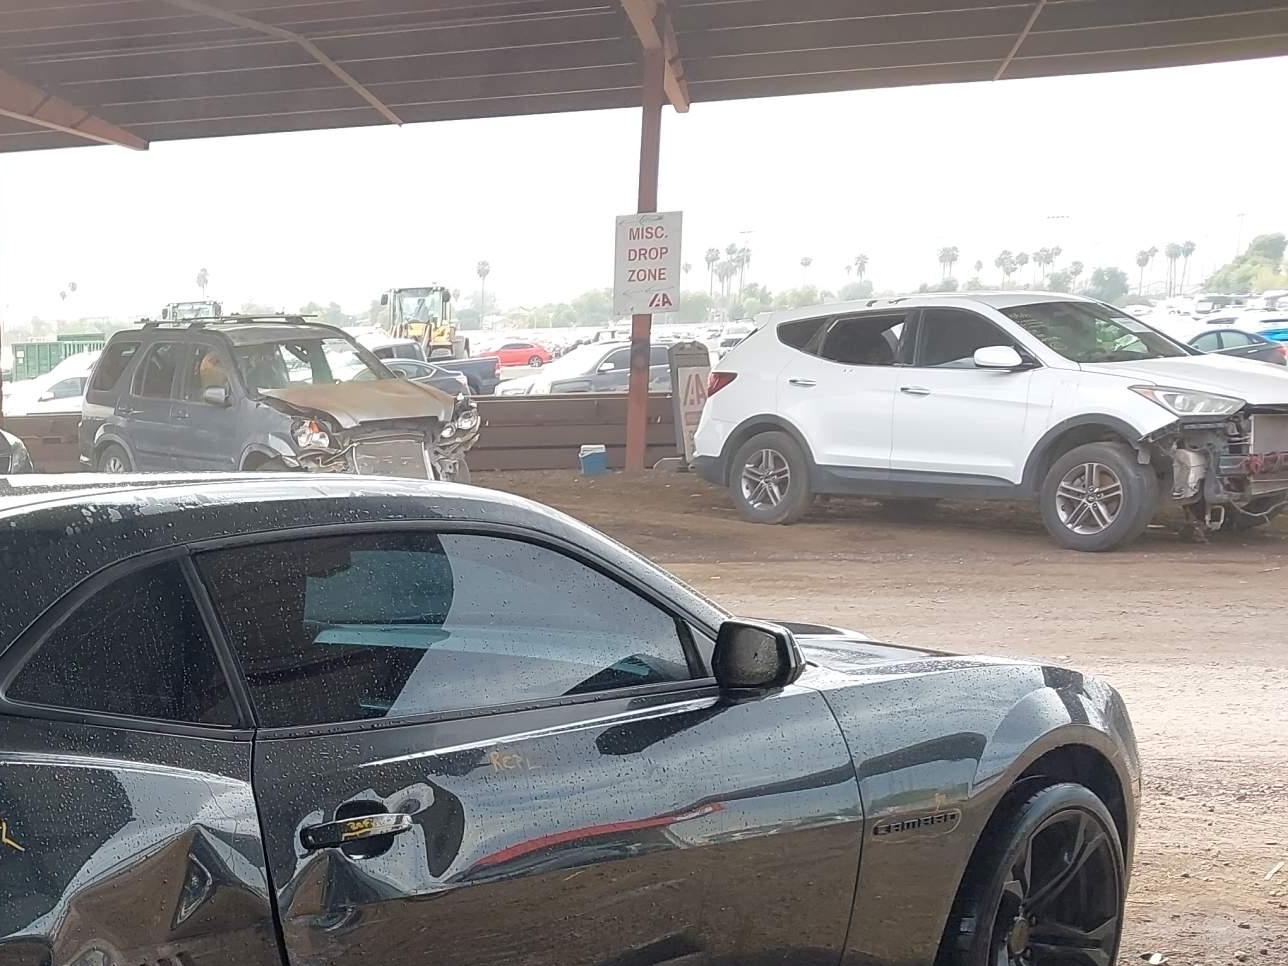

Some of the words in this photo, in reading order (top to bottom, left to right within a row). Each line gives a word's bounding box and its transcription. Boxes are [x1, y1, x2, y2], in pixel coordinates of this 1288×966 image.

[628, 225, 669, 241] MISC.
[627, 246, 669, 262] DROP
[627, 267, 667, 282] ZONE
